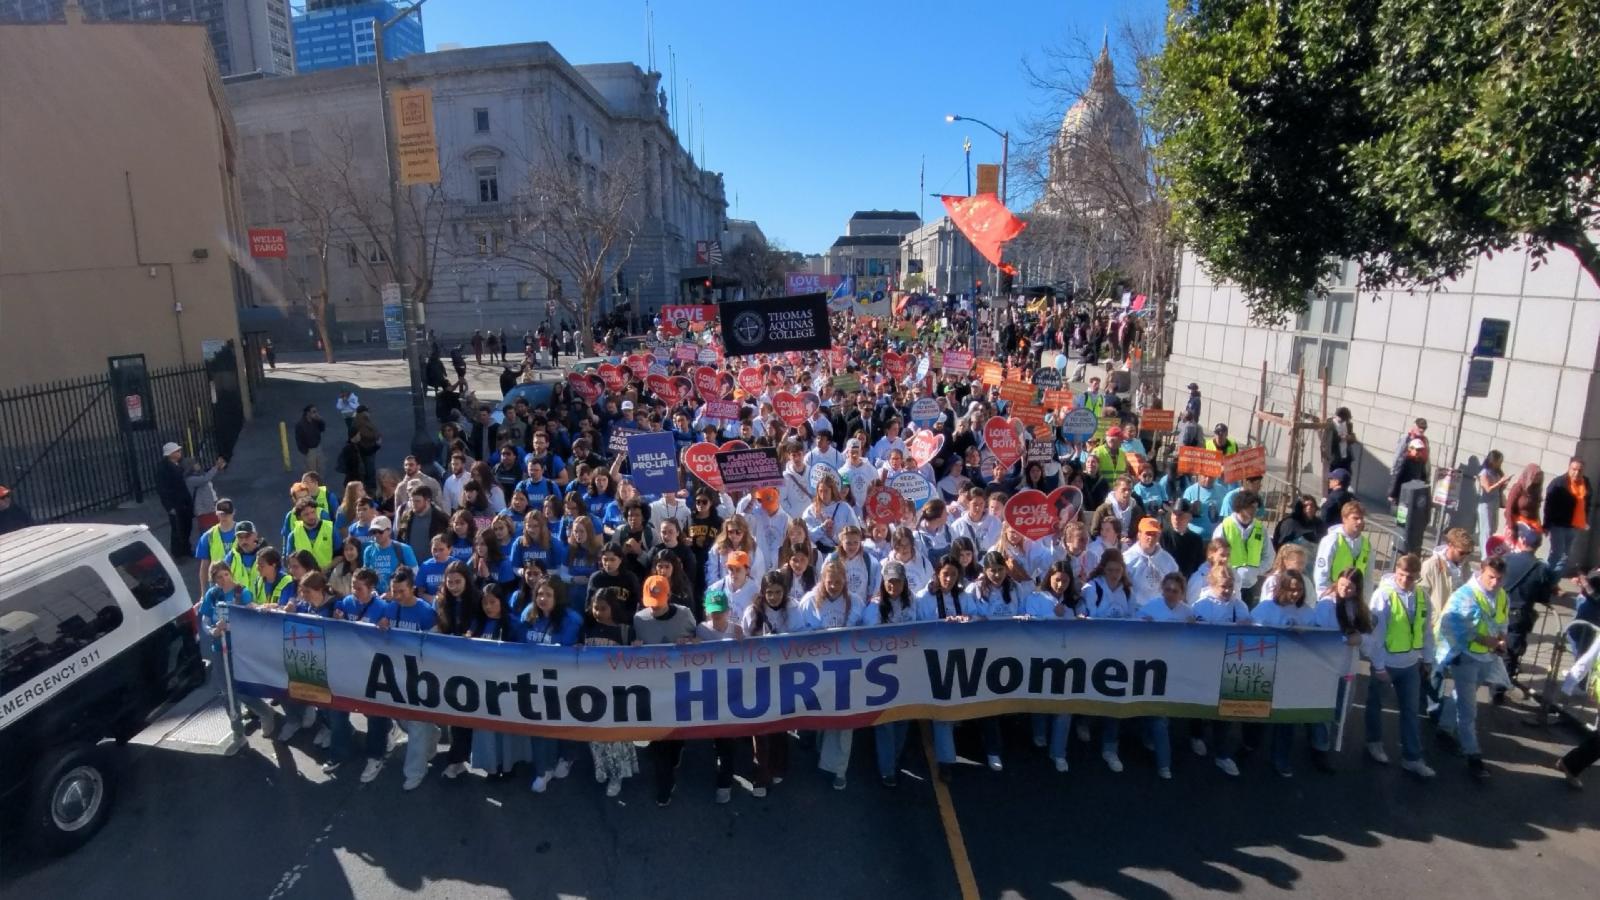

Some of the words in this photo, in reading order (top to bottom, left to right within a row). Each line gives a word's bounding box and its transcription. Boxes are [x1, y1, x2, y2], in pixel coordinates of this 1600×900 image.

[252, 235, 283, 243] WELLS
[254, 243, 284, 251] FARGO
[790, 276, 819, 286] LOVE
[666, 308, 703, 321] LOVE
[768, 308, 813, 321] THOMAS
[769, 318, 814, 332] AQUINAS
[769, 329, 816, 340] COLLEGE
[989, 429, 1011, 437] LOVE
[992, 440, 1016, 448] BOTH
[637, 452, 667, 461] HELLA
[727, 451, 766, 461] PLANNED
[1184, 450, 1217, 459] ABORTION
[632, 459, 675, 470] PRO-LIFE
[696, 464, 718, 472] BOT
[721, 457, 777, 469] PARENTHOOD
[723, 466, 747, 475] KILLS
[747, 464, 778, 473] BABIES
[904, 486, 928, 494] ABORTO
[1013, 504, 1048, 515] LOVE
[1015, 516, 1053, 526] BOTH
[286, 647, 317, 662] Walk
[607, 650, 672, 671] Walk
[681, 649, 715, 667] for
[727, 643, 770, 664] Life
[780, 637, 841, 660] West
[852, 631, 919, 653] Coast
[80, 649, 101, 667] 911
[295, 662, 326, 680] Life
[1226, 662, 1264, 676] Walk
[365, 652, 652, 722] Abortion
[674, 654, 900, 721] HURTS
[923, 647, 1168, 700] Women
[1234, 675, 1271, 694] Life
